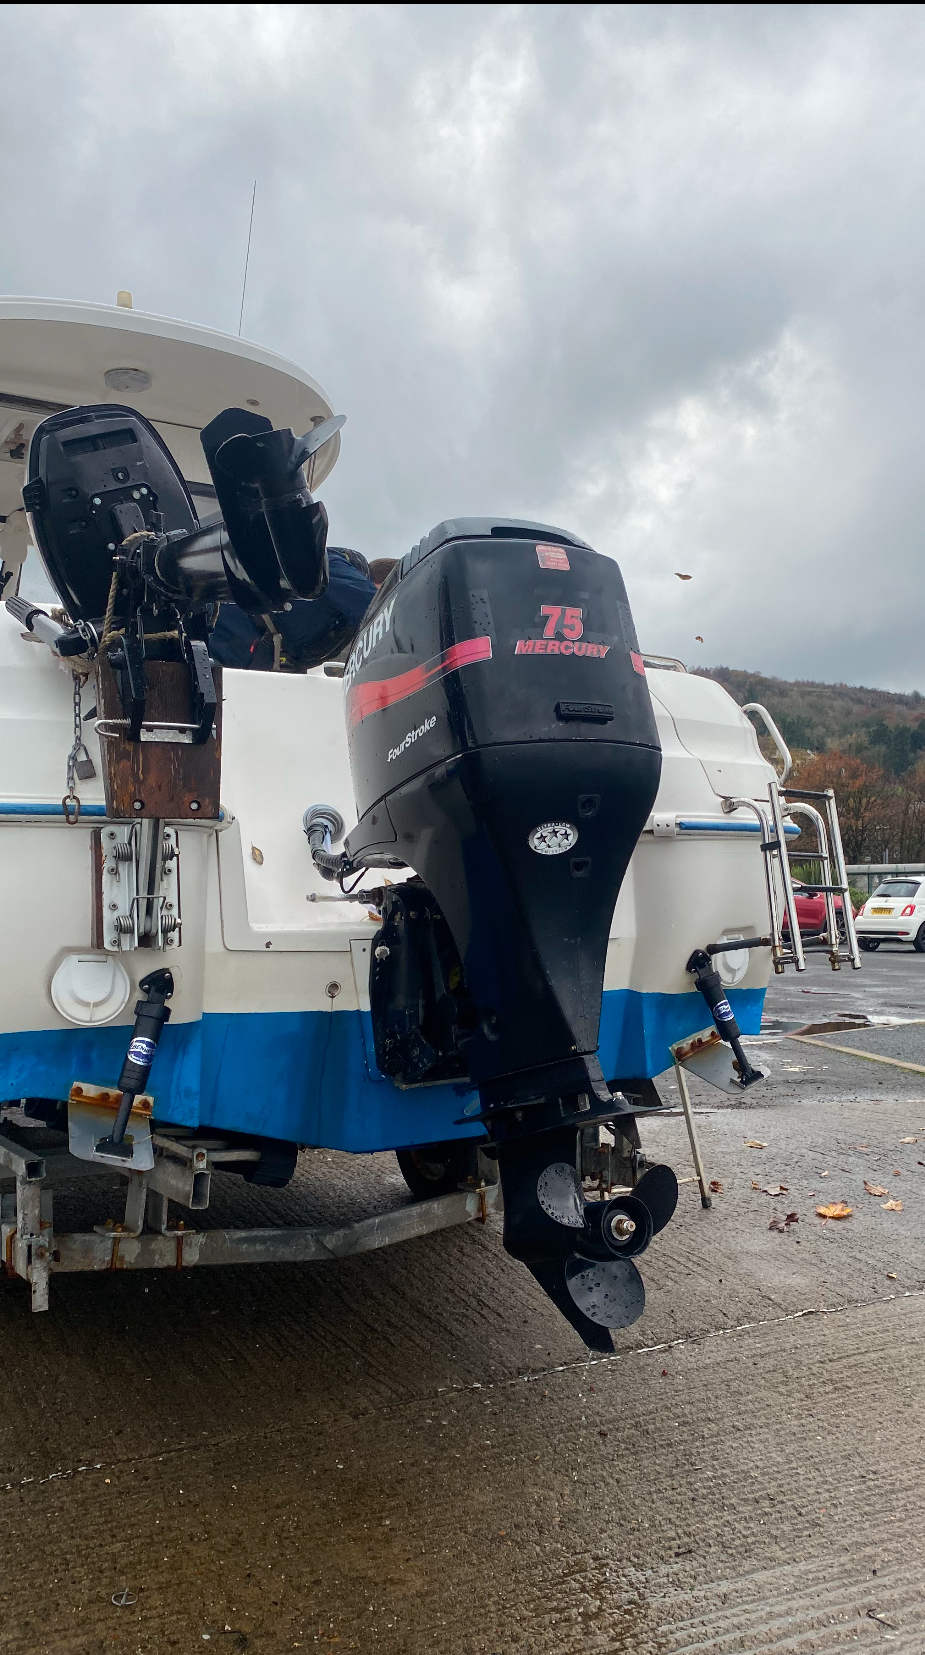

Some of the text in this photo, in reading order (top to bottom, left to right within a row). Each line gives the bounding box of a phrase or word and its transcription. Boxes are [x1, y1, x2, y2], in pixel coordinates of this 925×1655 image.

[541, 605, 584, 640] 75
[343, 592, 399, 697] ERCURY
[515, 639, 610, 659] MERCURY
[387, 715, 437, 762] FourStroke
